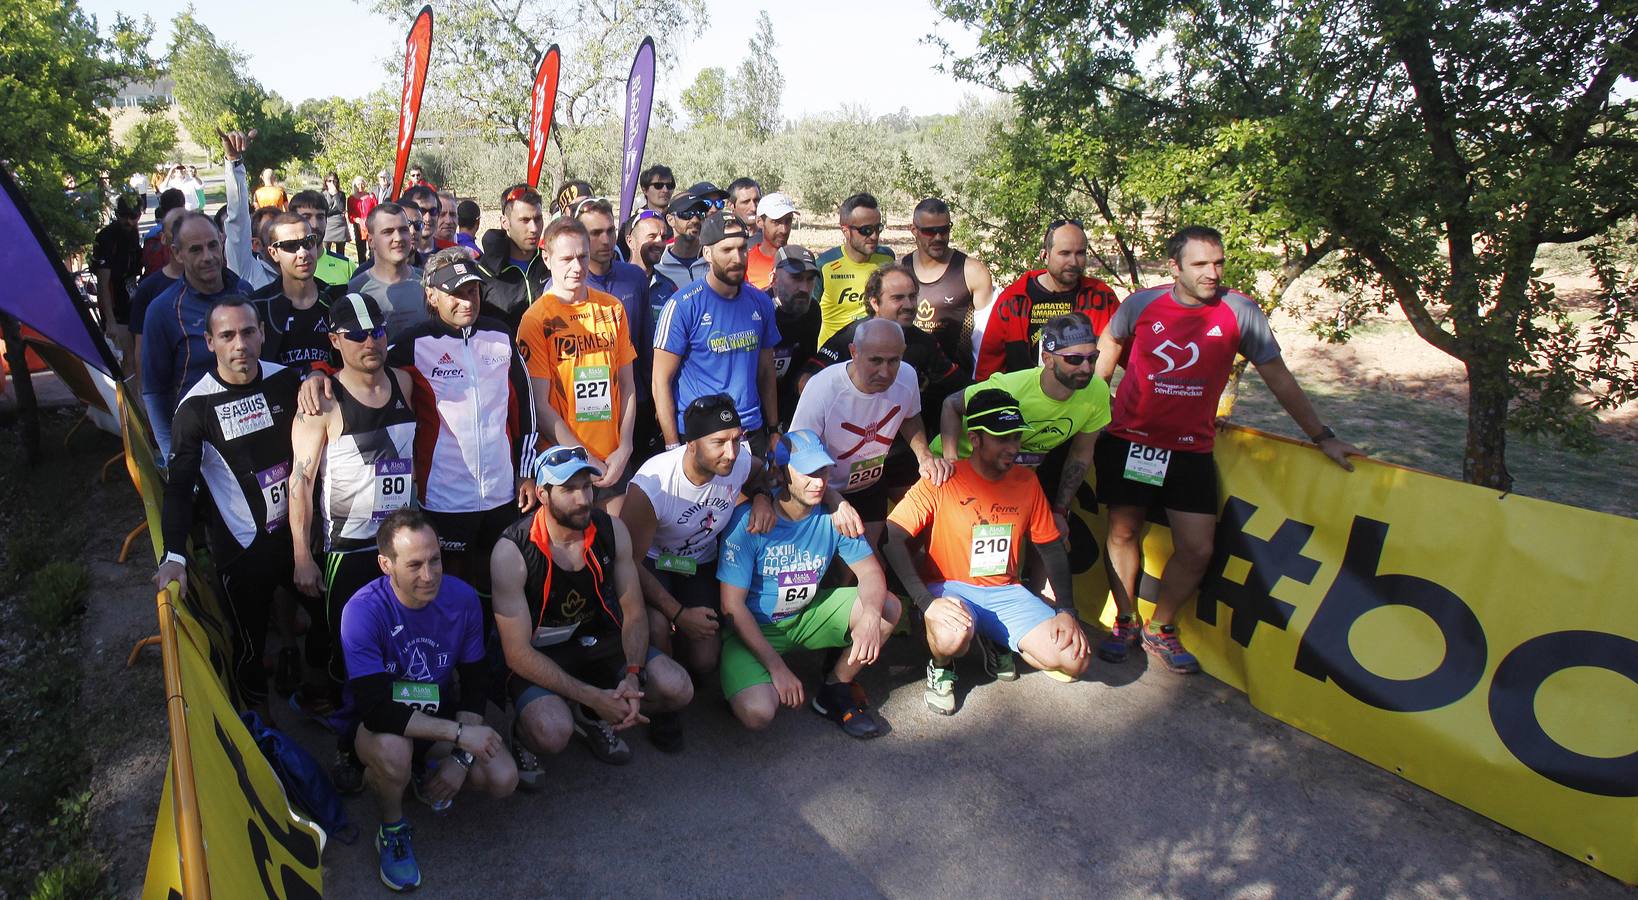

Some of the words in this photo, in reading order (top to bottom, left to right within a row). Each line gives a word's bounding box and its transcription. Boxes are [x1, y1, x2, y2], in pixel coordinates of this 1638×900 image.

[576, 381, 607, 399] 227
[1130, 443, 1168, 464] 204
[849, 467, 882, 485] 220
[271, 481, 287, 504] 61
[382, 476, 405, 495] 80
[677, 497, 729, 526] CORREDOR
[766, 544, 795, 556] XXIII
[974, 538, 1008, 554] 210
[765, 548, 811, 566] media
[785, 587, 808, 602] 64
[438, 654, 447, 663] 17
[385, 663, 396, 673] 20
